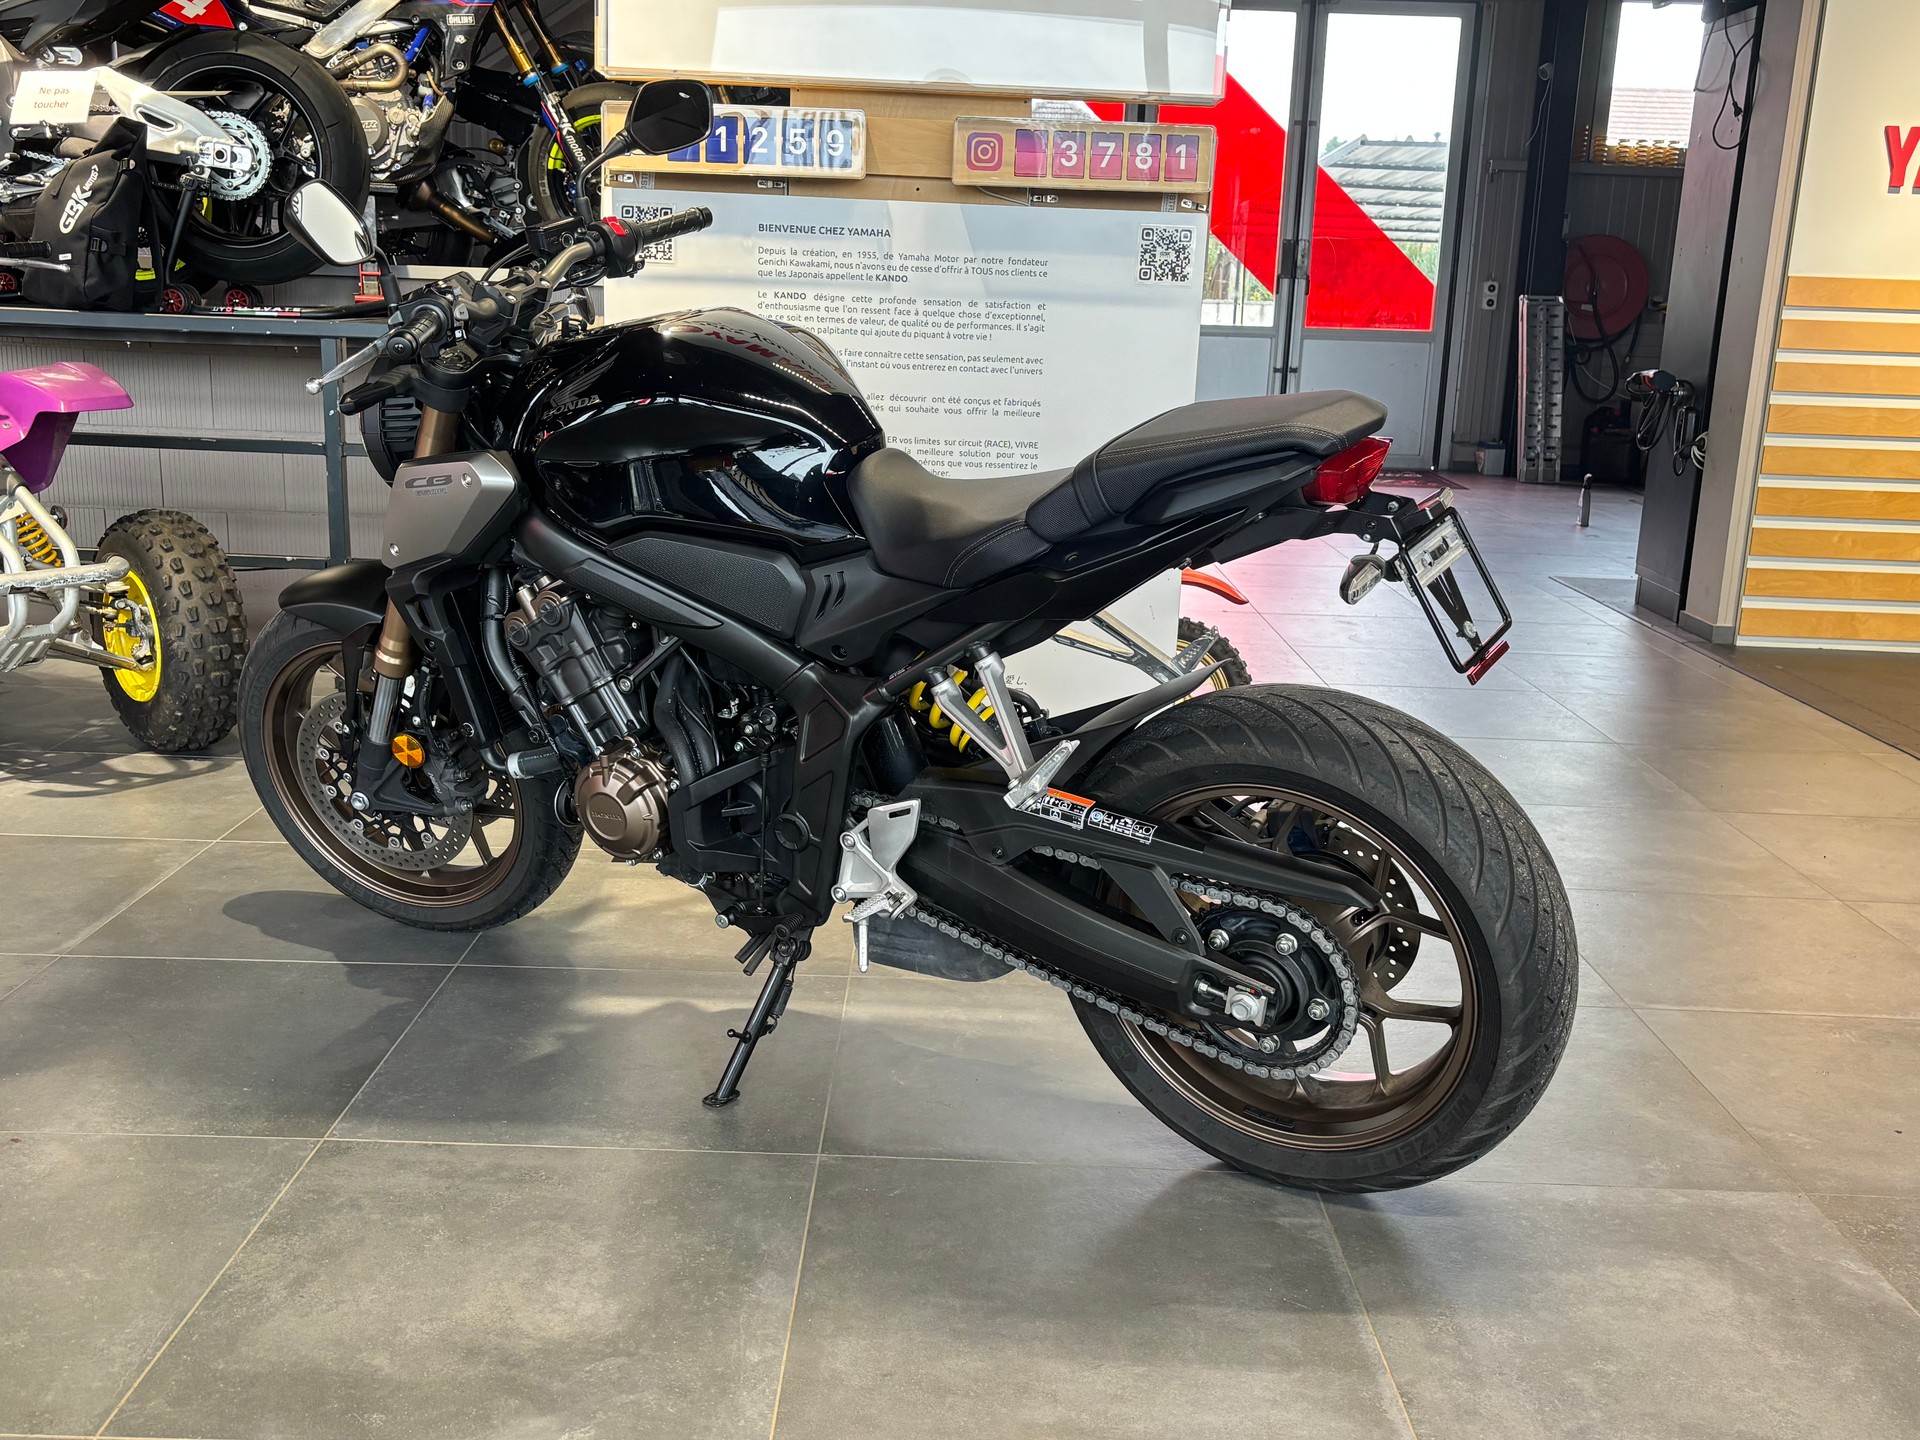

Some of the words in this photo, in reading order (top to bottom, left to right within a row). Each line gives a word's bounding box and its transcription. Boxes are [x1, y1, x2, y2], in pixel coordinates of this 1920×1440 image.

[39, 87, 52, 95] Ne
[54, 88, 70, 96] pas
[34, 100, 70, 109] toucher
[565, 135, 587, 162] motos
[1884, 125, 1920, 188] Y
[59, 184, 93, 234] GBK
[82, 169, 99, 191] MOTOS
[758, 223, 816, 235] BIENVENUE
[818, 226, 845, 236] CHEZ
[847, 227, 891, 238] YAMAHA
[758, 246, 786, 256] Depuis
[790, 247, 798, 256] la
[802, 248, 838, 258] création,
[858, 251, 879, 260] 1955,
[883, 252, 894, 260] de
[898, 252, 930, 262] Yamaha
[934, 254, 959, 263] Motor
[963, 256, 977, 265] par
[981, 256, 1004, 265] notre
[1008, 257, 1048, 267] fondateur
[758, 257, 788, 266] Genichi
[789, 259, 832, 269] Kawakami,
[834, 262, 854, 270] nous
[855, 262, 885, 271] n'avons
[886, 264, 897, 272] eu
[898, 263, 909, 272] de
[911, 265, 933, 273] cesse
[934, 265, 963, 274] d'offrir
[964, 266, 969, 274] à
[970, 266, 993, 275] TOUS
[1010, 268, 1037, 277] clients
[1038, 270, 1048, 278] ce
[758, 270, 773, 278] que
[775, 269, 787, 278] les
[788, 269, 824, 280] Japonais
[826, 271, 864, 281] appellent
[866, 273, 874, 281] le
[758, 290, 767, 298] Le
[774, 291, 807, 300] KANDO
[813, 292, 845, 303] désigne
[851, 295, 873, 303] cette
[879, 296, 917, 305] profonde
[923, 298, 962, 307] sensation
[968, 300, 979, 308] de
[985, 300, 1031, 310] satisfaction
[1037, 303, 1046, 311] et
[757, 301, 821, 312] d'enthousiasme
[824, 305, 839, 314] que
[842, 305, 858, 313] l'on
[861, 306, 891, 315] ressent
[894, 307, 911, 316] face
[914, 308, 919, 316] à
[922, 309, 955, 319] quelque
[958, 310, 982, 319] chose
[984, 310, 1046, 322] d'exceptionnel,
[787, 314, 802, 322] soit
[817, 315, 845, 324] termes
[847, 316, 857, 324] de
[860, 316, 887, 326] valeur,
[889, 318, 899, 326] de
[901, 320, 929, 329] qualité
[944, 320, 955, 329] de
[956, 321, 1014, 332] performances.
[1023, 323, 1045, 333] s'agit
[817, 325, 858, 335] palpitante
[860, 328, 873, 337] qui
[874, 328, 899, 338] ajoute
[901, 329, 912, 338] du
[913, 330, 944, 340] piquant
[946, 331, 951, 339] à
[953, 332, 974, 340] votre
[976, 332, 987, 341] vie
[844, 349, 862, 359] faire
[864, 350, 901, 360] connaître
[903, 352, 924, 360] cette
[925, 352, 966, 363] sensation,
[967, 355, 980, 364] pas
[982, 355, 1024, 364] seulement
[1025, 357, 1043, 365] avec
[846, 359, 878, 369] l'instant
[880, 361, 890, 369] où
[911, 363, 946, 372] entrerez
[959, 364, 989, 374] contact
[990, 366, 1008, 374] avec
[1009, 366, 1043, 375] l'univers
[542, 394, 603, 421] HONDA
[866, 392, 885, 401] allez
[889, 394, 927, 403] découvrir
[931, 396, 946, 404] ont
[948, 395, 961, 404] été
[963, 397, 991, 406] conçus
[992, 398, 1002, 406] et
[1003, 397, 1041, 408] fabriqués
[888, 404, 901, 413] qui
[905, 405, 939, 414] souhaite
[943, 407, 962, 415] vous
[966, 407, 987, 416] offrir
[992, 408, 999, 417] la
[1003, 408, 1040, 418] meilleure
[914, 436, 941, 446] limites
[944, 439, 957, 447] sur
[958, 438, 983, 447] circuit
[984, 439, 1013, 450] (RACE),
[1014, 441, 1039, 450] VIVRE
[916, 447, 954, 457] meilleure
[959, 449, 991, 459] solution
[996, 452, 1015, 460] pour
[1019, 452, 1039, 460] vous
[947, 460, 962, 469] que
[964, 461, 983, 469] vous
[984, 461, 1028, 471] ressentirez
[1030, 462, 1038, 471] le
[405, 474, 454, 489] CB
[591, 811, 624, 822] HONDA
[342, 880, 432, 920] METZELER
